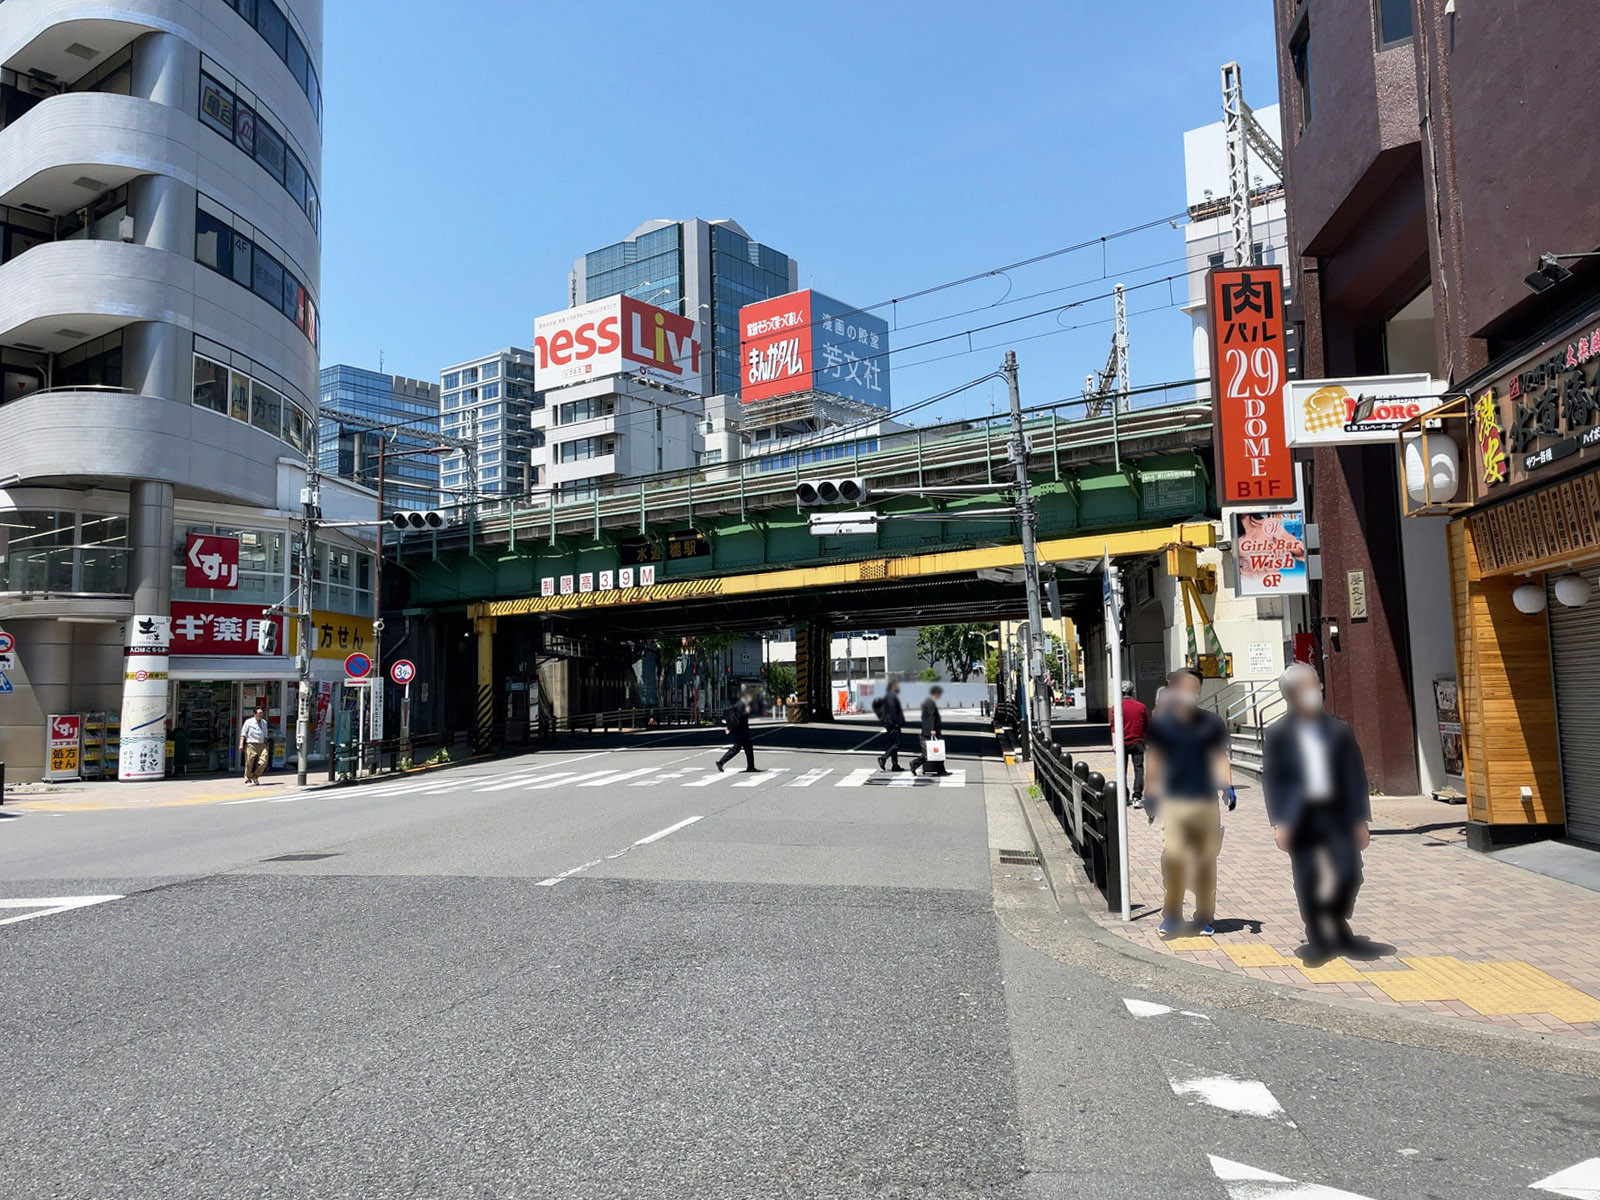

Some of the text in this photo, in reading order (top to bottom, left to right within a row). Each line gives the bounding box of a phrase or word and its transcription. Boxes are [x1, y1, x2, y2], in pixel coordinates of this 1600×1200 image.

[1222, 273, 1274, 322] 肉
[1223, 321, 1277, 344] バル
[748, 337, 803, 384] まんがタイム
[822, 342, 882, 392] 芳文社
[1226, 347, 1280, 399] 29
[1244, 399, 1270, 477] DOME
[1237, 480, 1281, 497] B1F
[1241, 539, 1299, 551] Girls Bar
[188, 538, 238, 587] くすり
[1250, 553, 1294, 569] Wish
[1262, 573, 1281, 588] 6F
[311, 622, 364, 650] 方せん
[53, 717, 78, 738] くすり
[53, 749, 76, 758] 処方
[53, 760, 76, 769] せん
